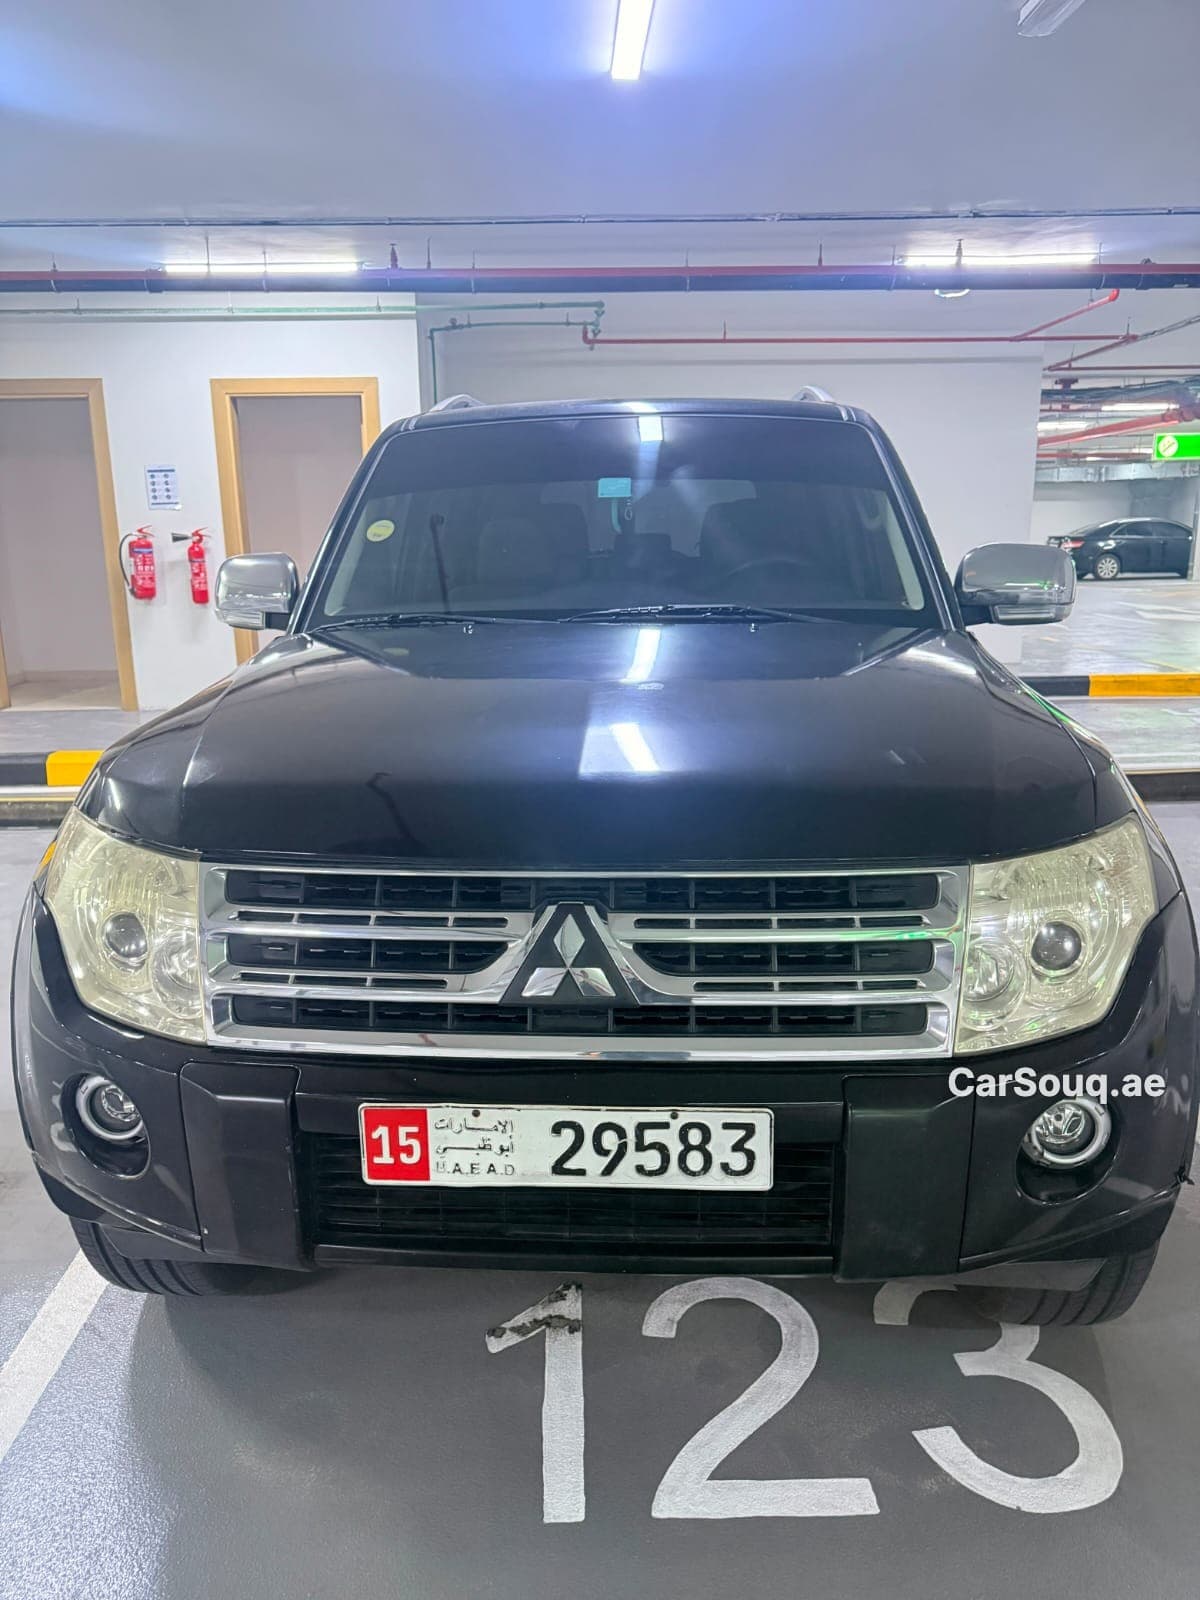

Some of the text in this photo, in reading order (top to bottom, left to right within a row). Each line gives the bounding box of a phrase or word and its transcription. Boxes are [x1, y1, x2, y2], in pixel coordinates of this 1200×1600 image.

[371, 1125, 424, 1165] 15
[550, 1120, 757, 1178] 29583
[485, 1276, 1123, 1523] 123
